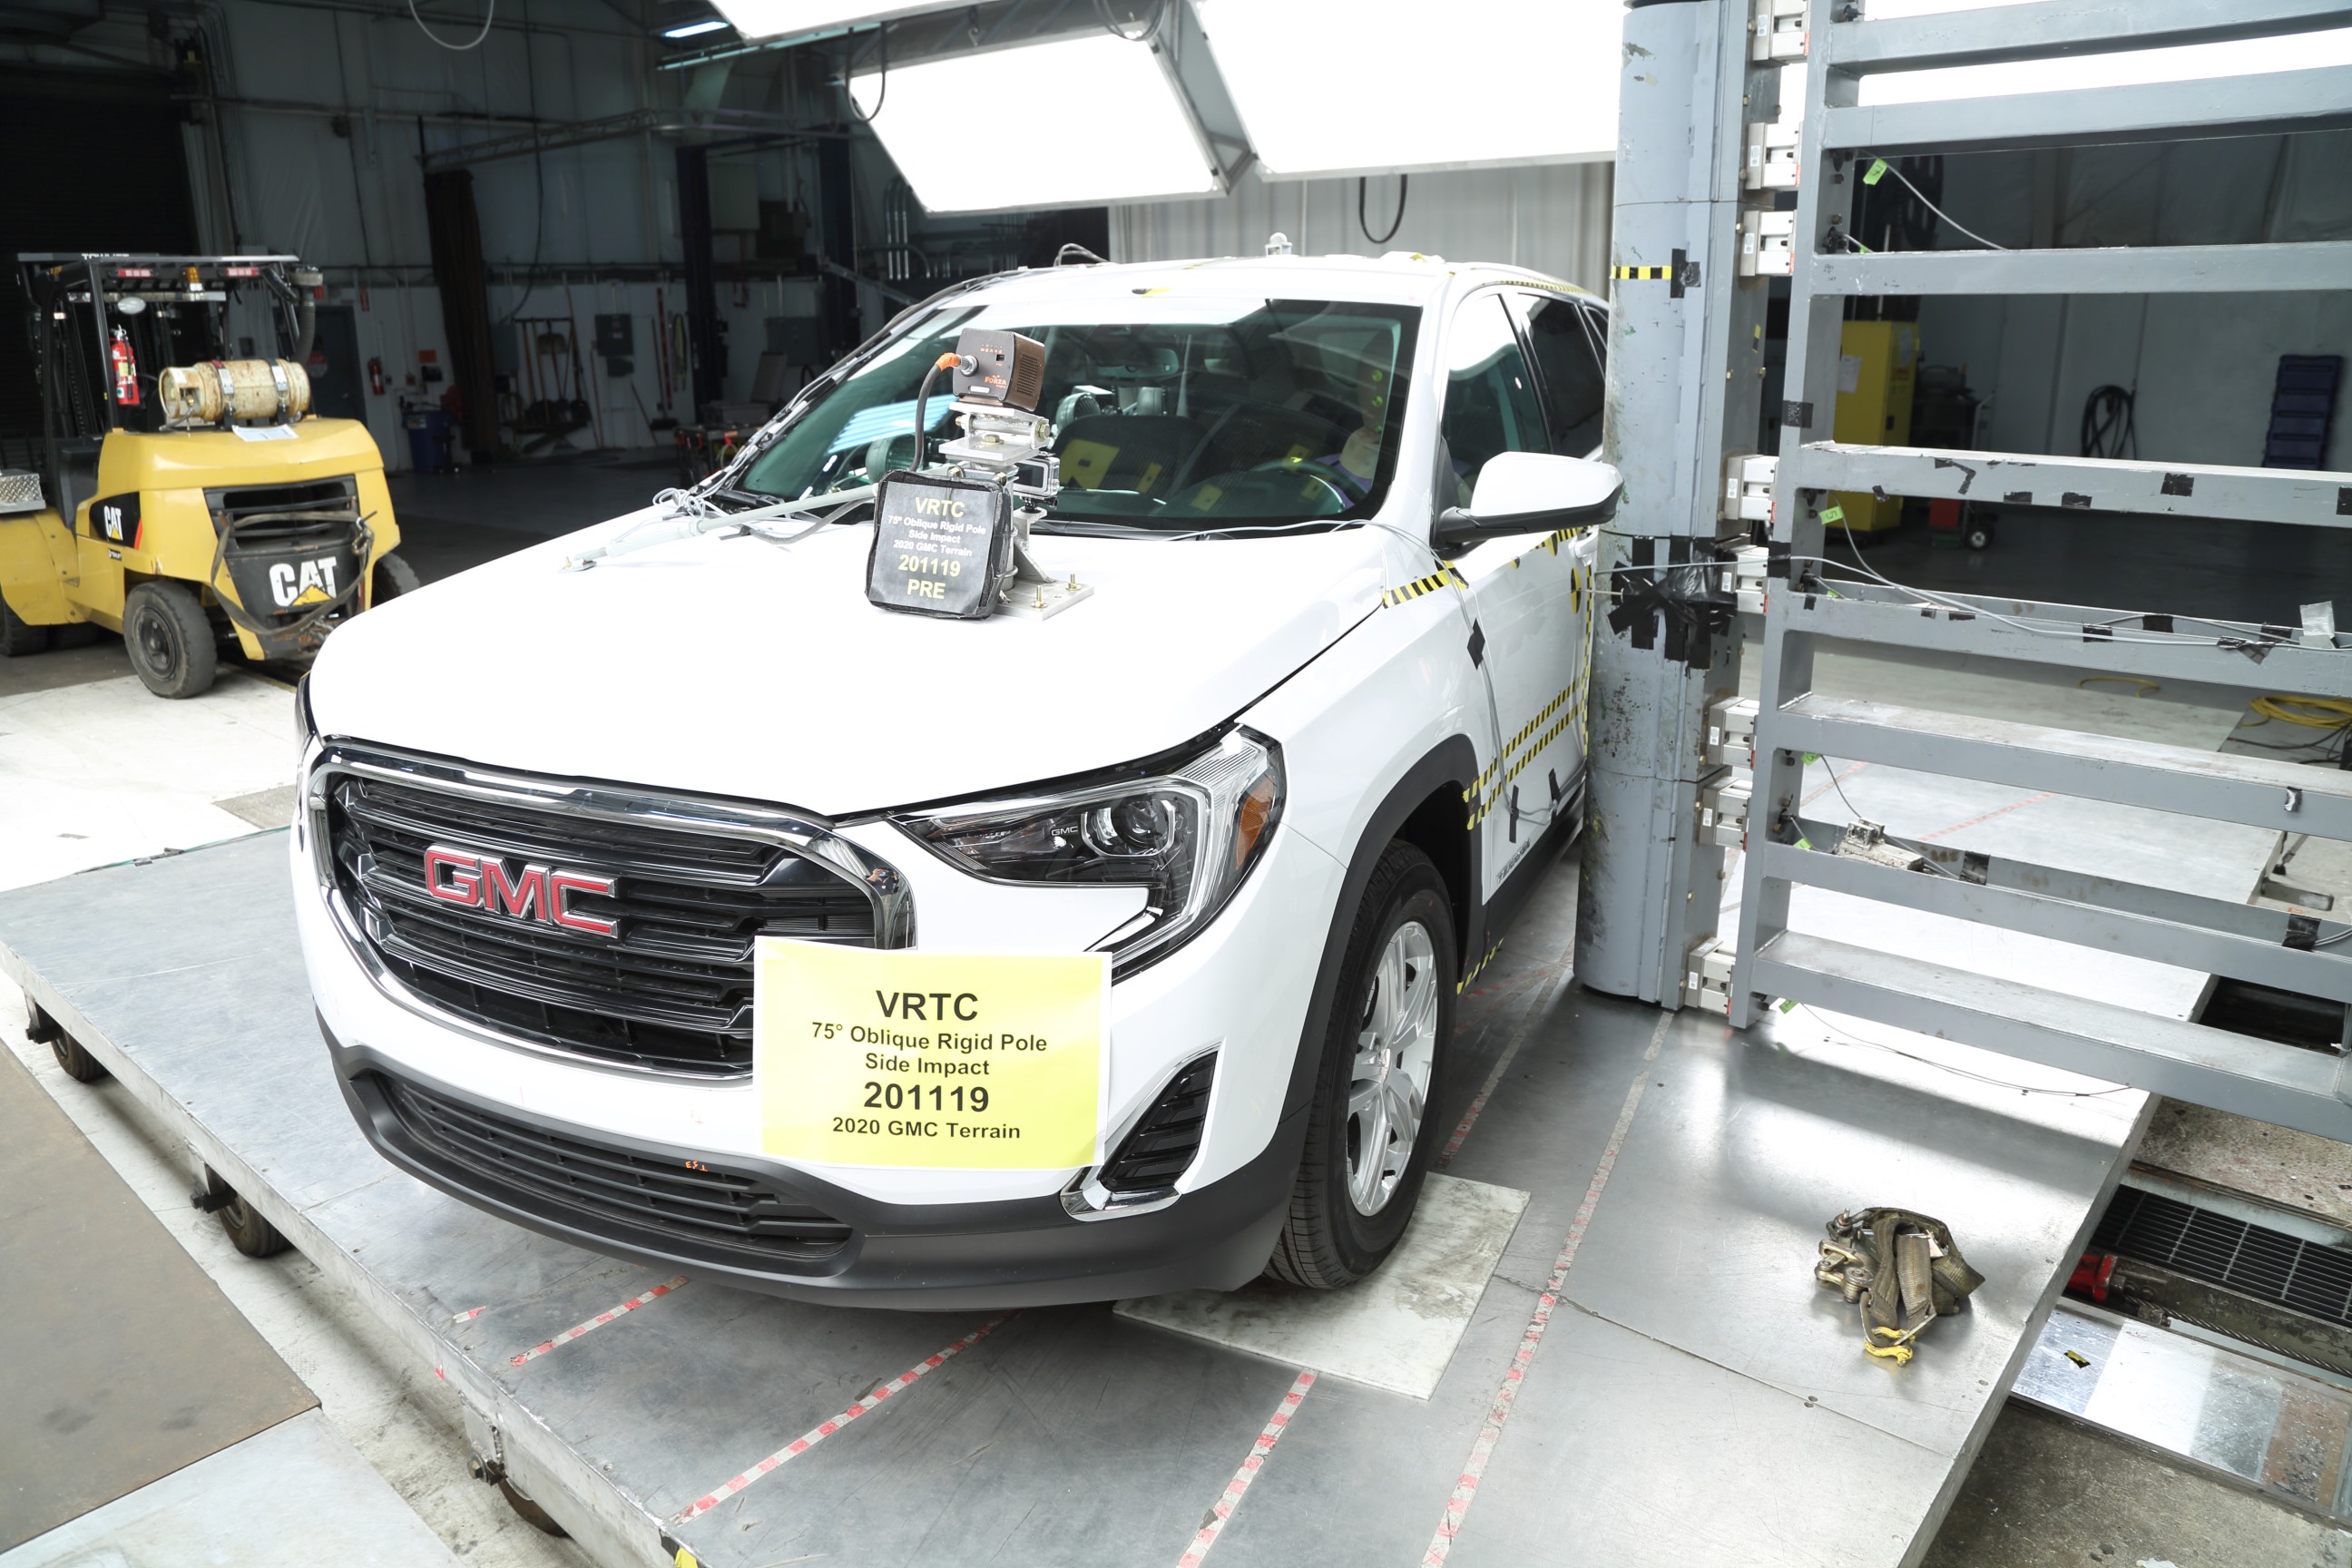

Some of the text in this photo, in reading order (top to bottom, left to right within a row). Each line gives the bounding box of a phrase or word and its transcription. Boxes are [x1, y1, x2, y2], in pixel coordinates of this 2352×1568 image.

[915, 496, 965, 518] VRTC
[103, 505, 123, 541] CAT
[903, 517, 938, 529] Oblique
[939, 521, 964, 534] Rigid
[965, 524, 986, 534] Pole
[893, 539, 973, 557] 2020 GMC Terrain
[908, 529, 961, 544] Side Impact
[897, 554, 961, 577] 201119
[270, 556, 337, 607] CAT
[907, 578, 946, 600] PRE
[1051, 826, 1078, 836] GMC
[424, 845, 620, 939] GMC
[876, 990, 979, 1022] VRTC
[850, 1025, 930, 1051] Oblique
[937, 1033, 993, 1054] Rigid
[1001, 1034, 1047, 1051] Pole
[865, 1053, 990, 1077] Side Impact
[864, 1081, 989, 1112] 201119
[832, 1117, 1021, 1139] 2020 GMC Terrain
